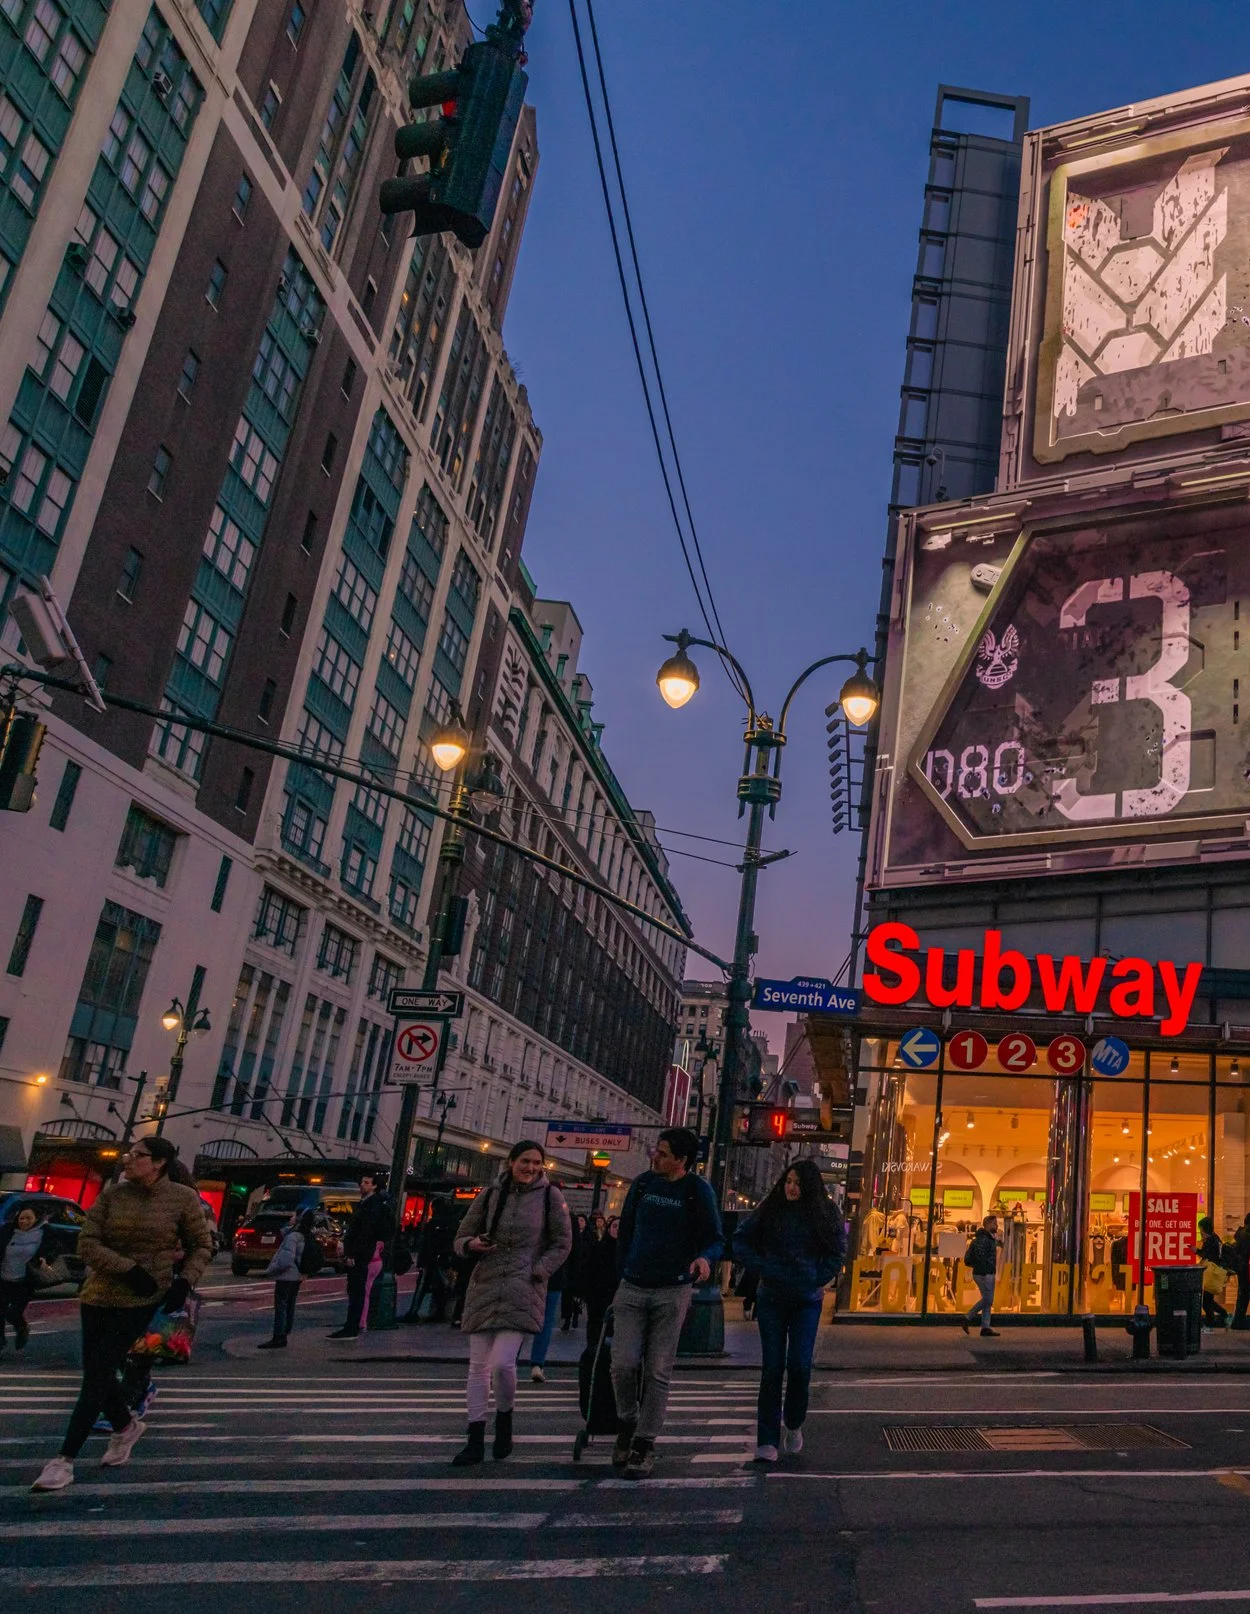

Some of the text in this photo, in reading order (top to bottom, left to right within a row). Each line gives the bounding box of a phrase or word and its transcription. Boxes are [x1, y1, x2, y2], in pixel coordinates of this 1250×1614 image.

[1052, 570, 1192, 821] 3
[863, 922, 1203, 1037] Subway
[402, 998, 448, 1007] ONE WAY
[762, 987, 856, 1010] Seventh Ave
[960, 1038, 1077, 1068] 1 2 3
[774, 1114, 785, 1136] 4
[793, 1122, 818, 1131] Subway
[575, 1136, 622, 1147] BUSES ONLY
[830, 1161, 843, 1169] OLD
[1147, 1198, 1180, 1214] SALE
[1165, 1220, 1178, 1229] GET
[1178, 1220, 1192, 1229] ONE
